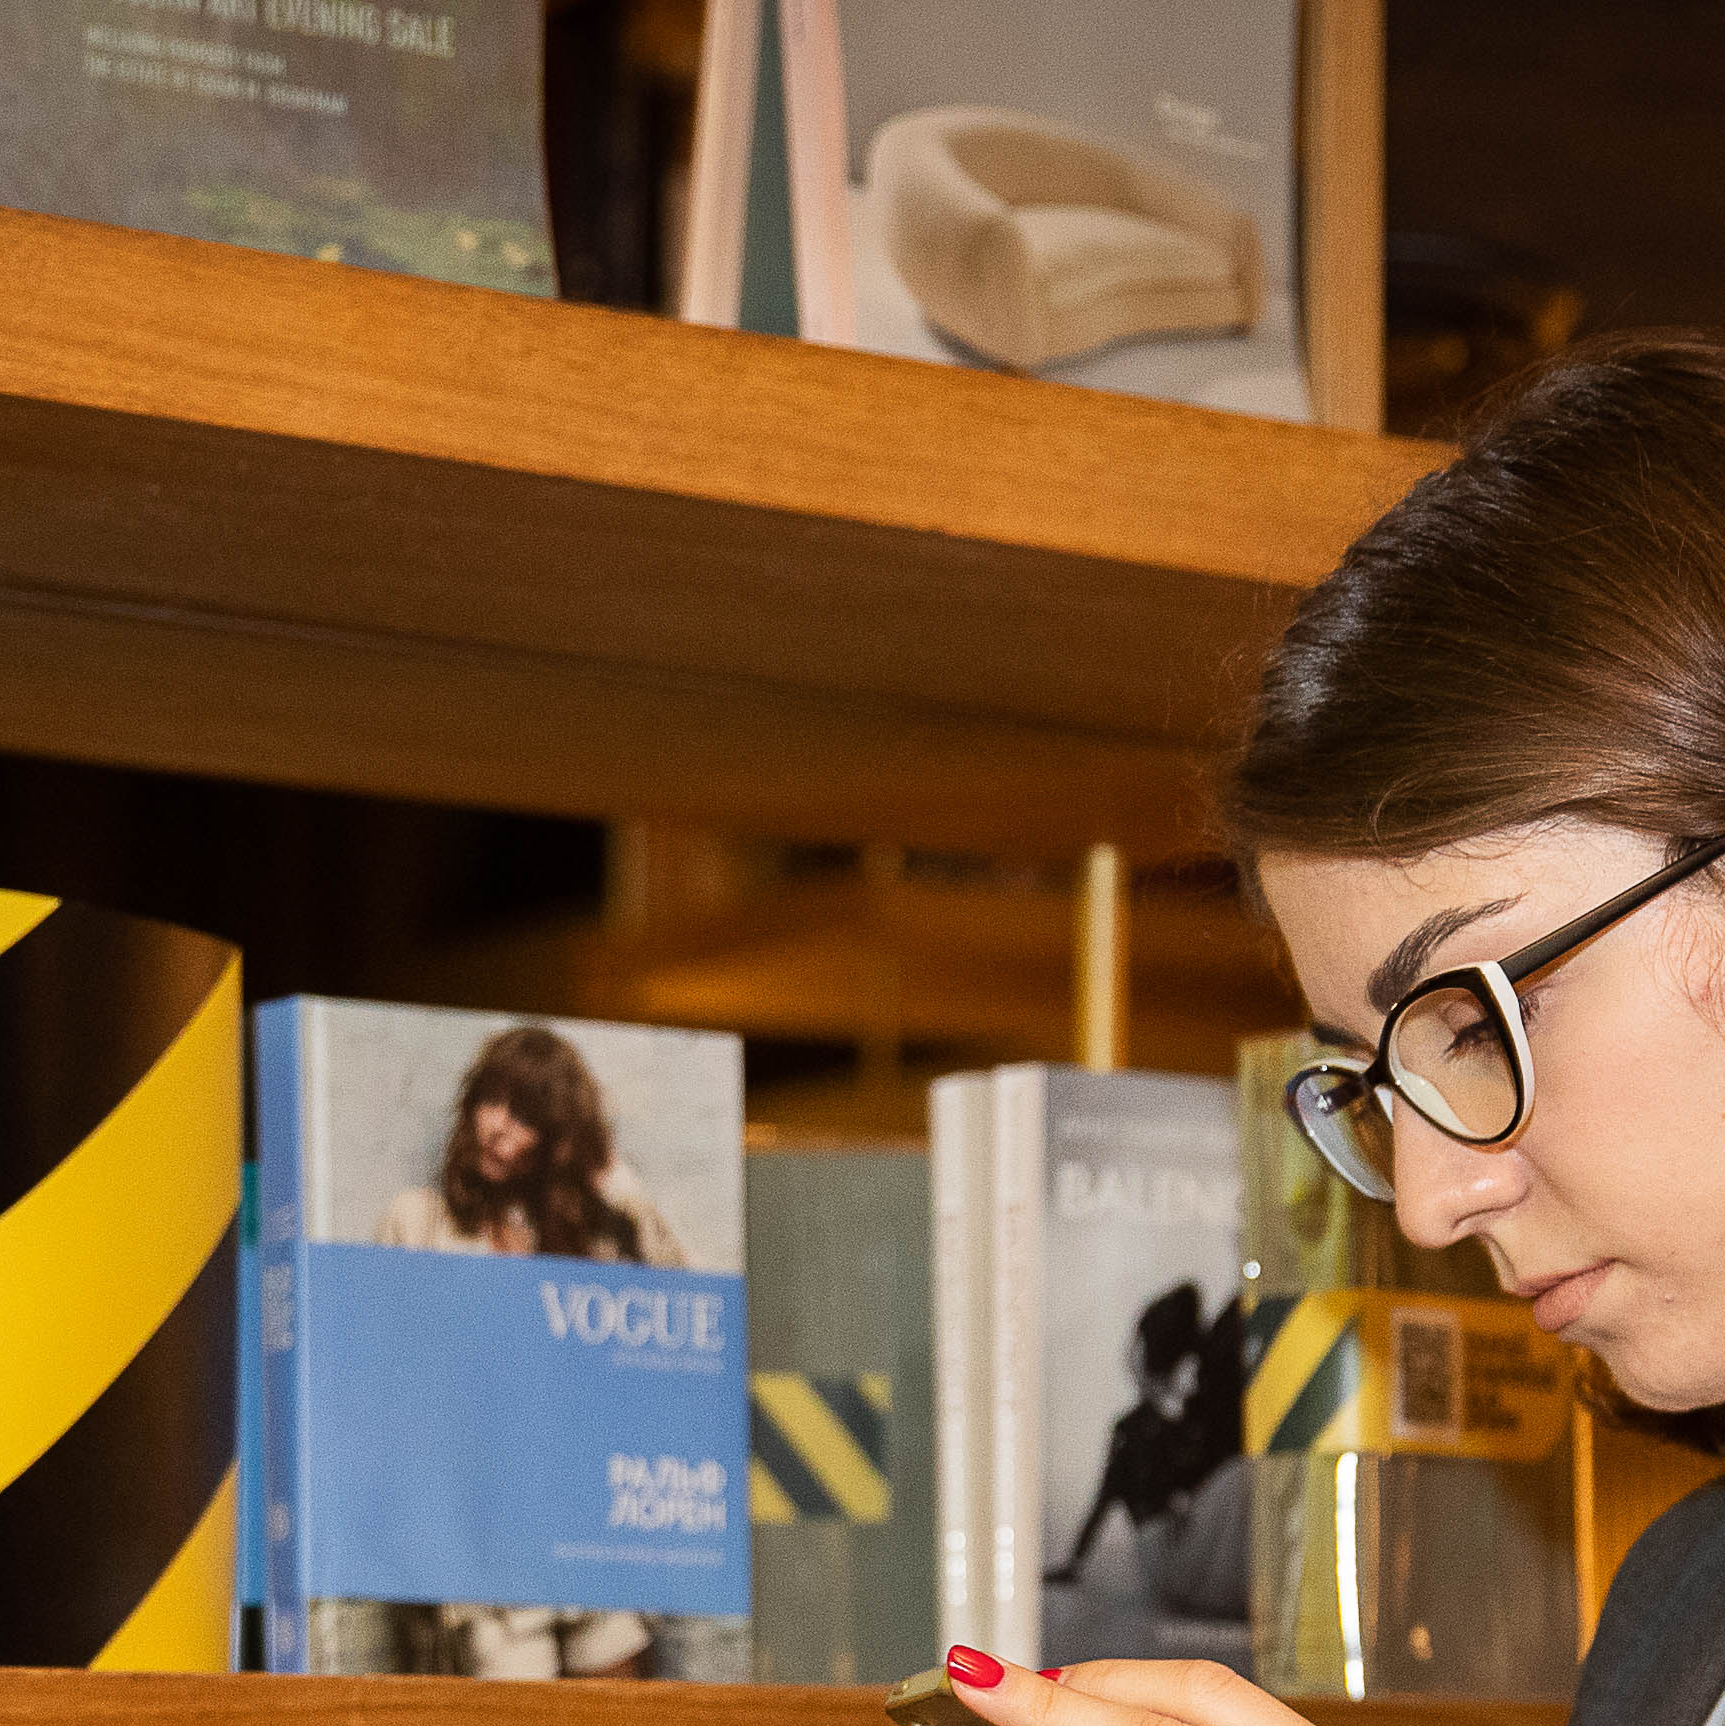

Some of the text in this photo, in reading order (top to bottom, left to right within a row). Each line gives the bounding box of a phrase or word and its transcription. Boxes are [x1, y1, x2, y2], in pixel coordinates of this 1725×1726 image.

[265, 0, 377, 45] EVENING
[386, 9, 455, 59] SALE
[540, 1281, 727, 1353] VOGUE
